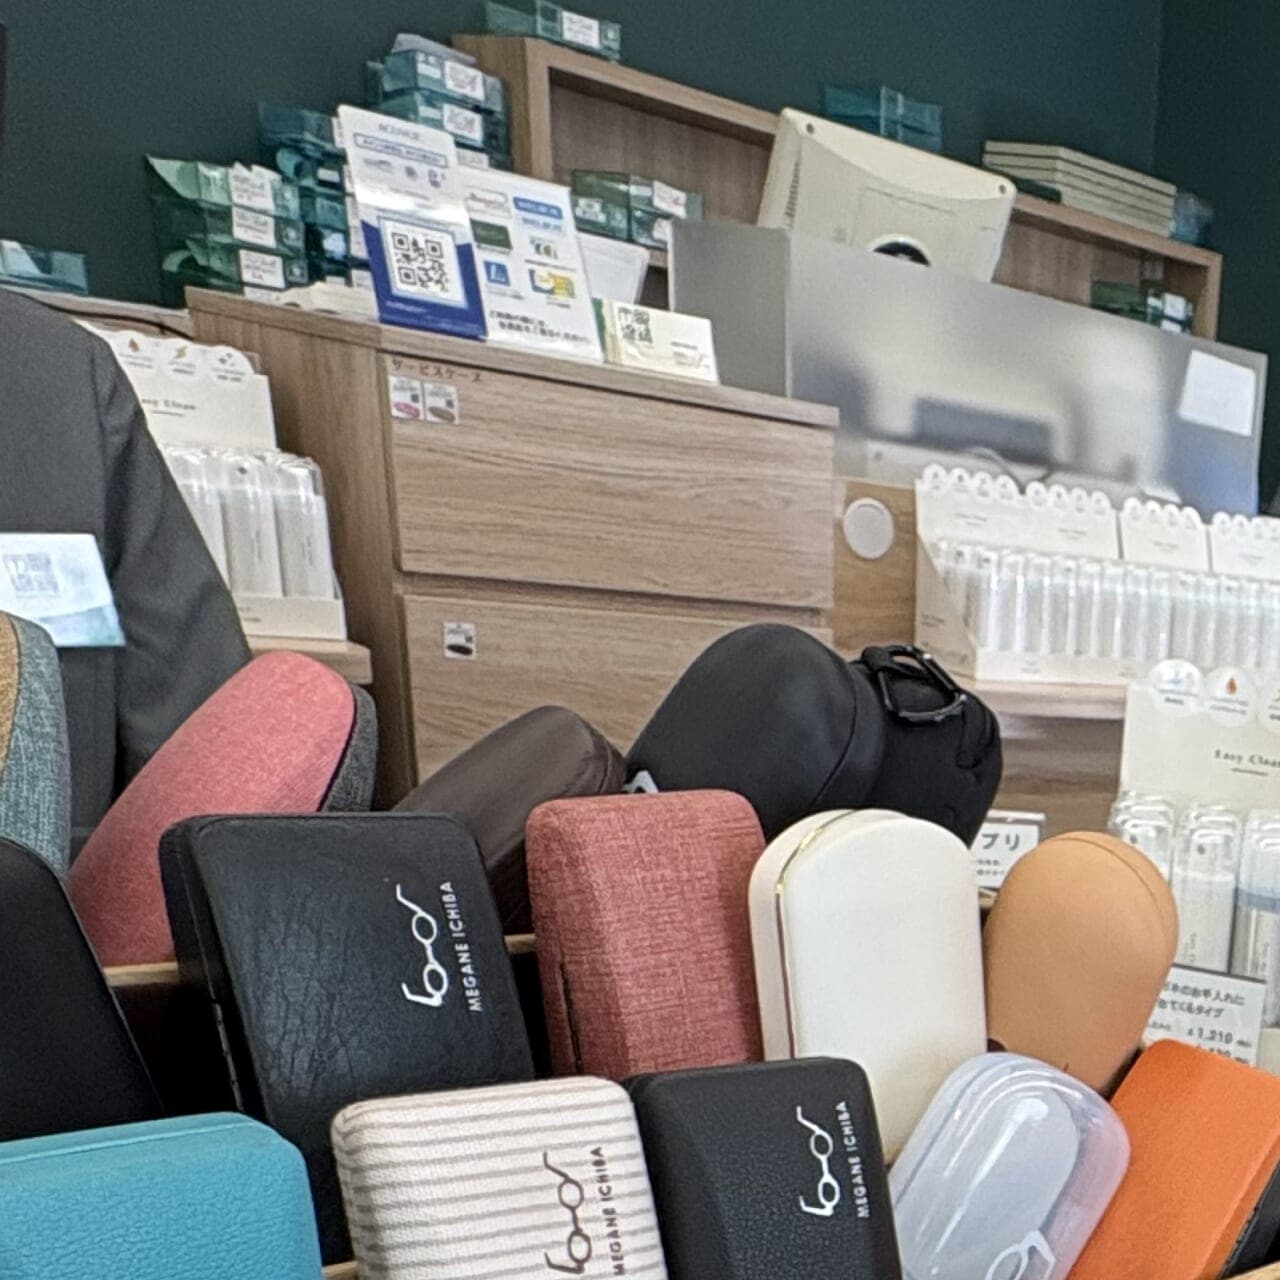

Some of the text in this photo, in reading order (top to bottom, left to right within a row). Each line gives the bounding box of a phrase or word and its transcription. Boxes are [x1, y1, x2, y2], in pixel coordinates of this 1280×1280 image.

[439, 880, 484, 1012] MEGANE ICHIBA
[590, 1146, 626, 1276] MEGANE ICHIBA
[835, 1100, 871, 1219] MEGANE ICHIBA
